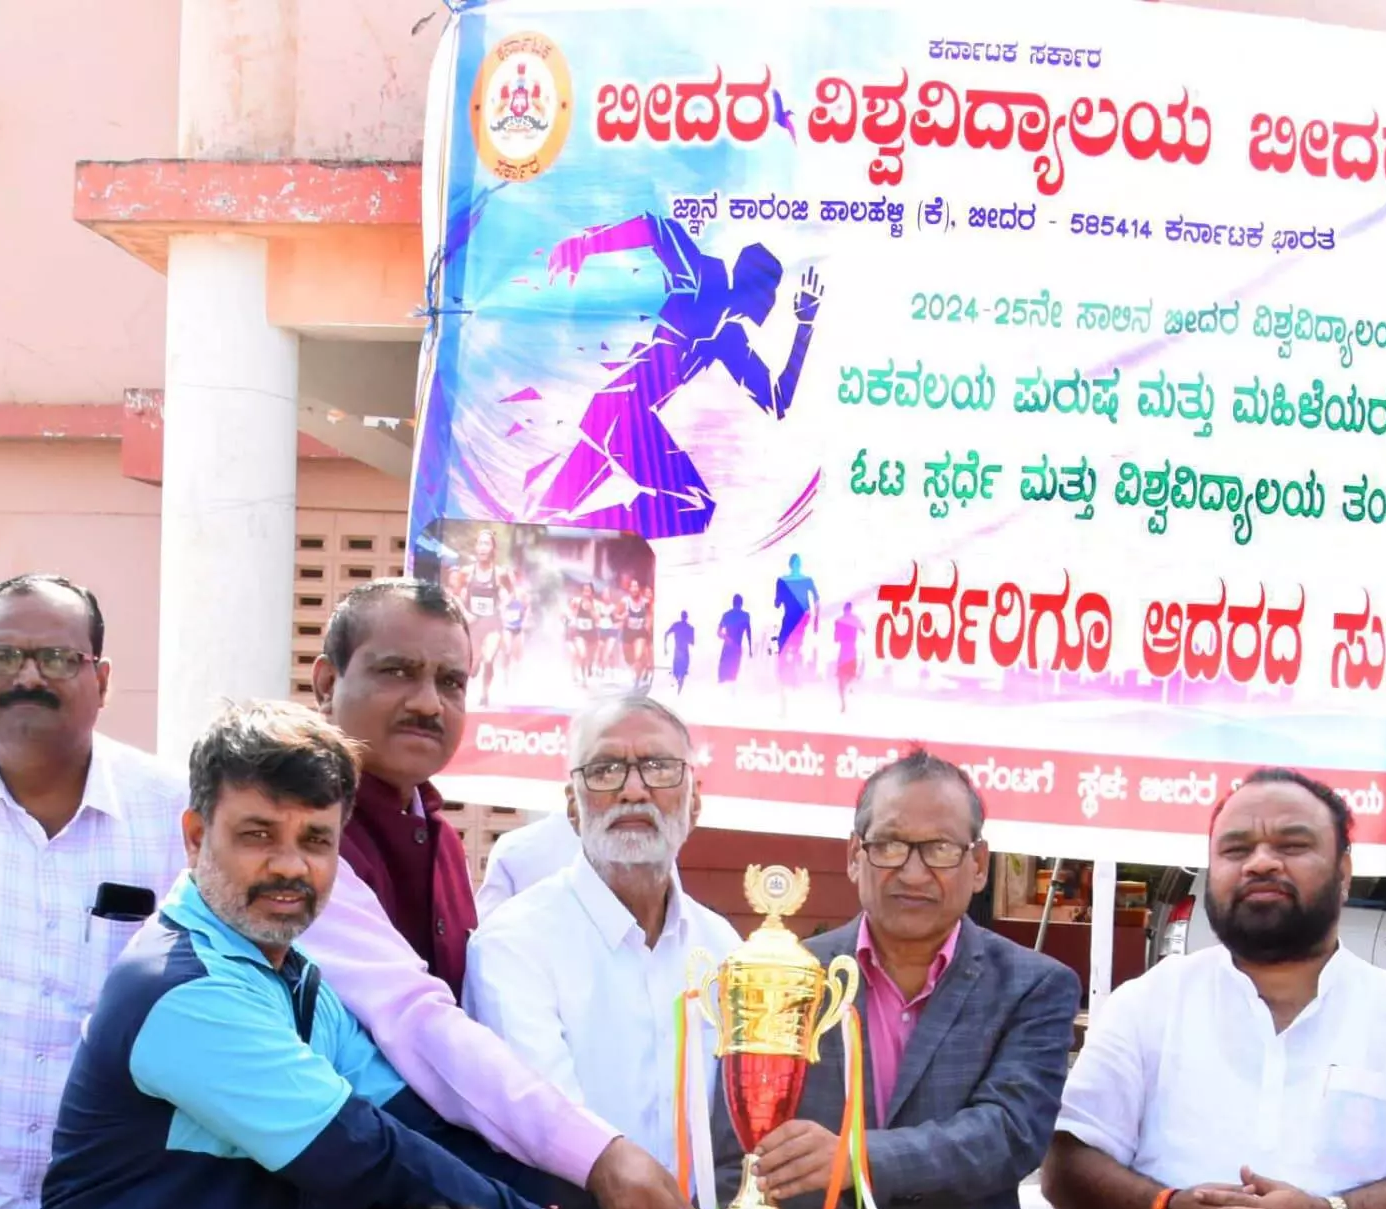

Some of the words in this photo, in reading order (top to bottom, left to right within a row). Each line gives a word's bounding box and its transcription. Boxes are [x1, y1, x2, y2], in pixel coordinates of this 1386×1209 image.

[928, 37, 1018, 63] ಕರ್ನಾಟಕ
[1030, 42, 1103, 69] ಸರ್ಕಾರ
[596, 63, 772, 142] ಬೀದರ
[808, 66, 1212, 196] ವಿಶ್ವವಿದ್ಯಾಲಯ
[673, 192, 718, 236] ಜ್ಞಾನ
[728, 192, 809, 221] ಕಾರಂಜಿ
[820, 195, 905, 239] ಹಾಲಹಳ್ಳಿ
[967, 202, 1037, 231] ಬೀದರ
[1069, 212, 1153, 240] 585414
[1164, 213, 1264, 248] ಕರ್ನಾಟಕ
[1270, 225, 1336, 254] ಭಾರತ
[911, 288, 1063, 329] 2024-25ನೇ
[1076, 296, 1153, 334] ಸಾಲಿನ
[1164, 299, 1240, 336] ಬೀದರ
[837, 357, 996, 411] ಏಕವಲಯ
[1013, 365, 1121, 424] ಪುರುಷ
[1138, 368, 1215, 438] ಮತ್ತು
[850, 448, 906, 497] ಓಟ
[923, 449, 1003, 519] ಸ್ಪರ್ಧೆ
[1020, 453, 1097, 520] ಮತ್ತು
[1115, 458, 1326, 546] ವಿಶ್ವವಿದ್ಯಾಲಯ
[875, 558, 1113, 673] ಸರ್ವರಿಗೂ
[1142, 576, 1306, 686] ಆದರದ
